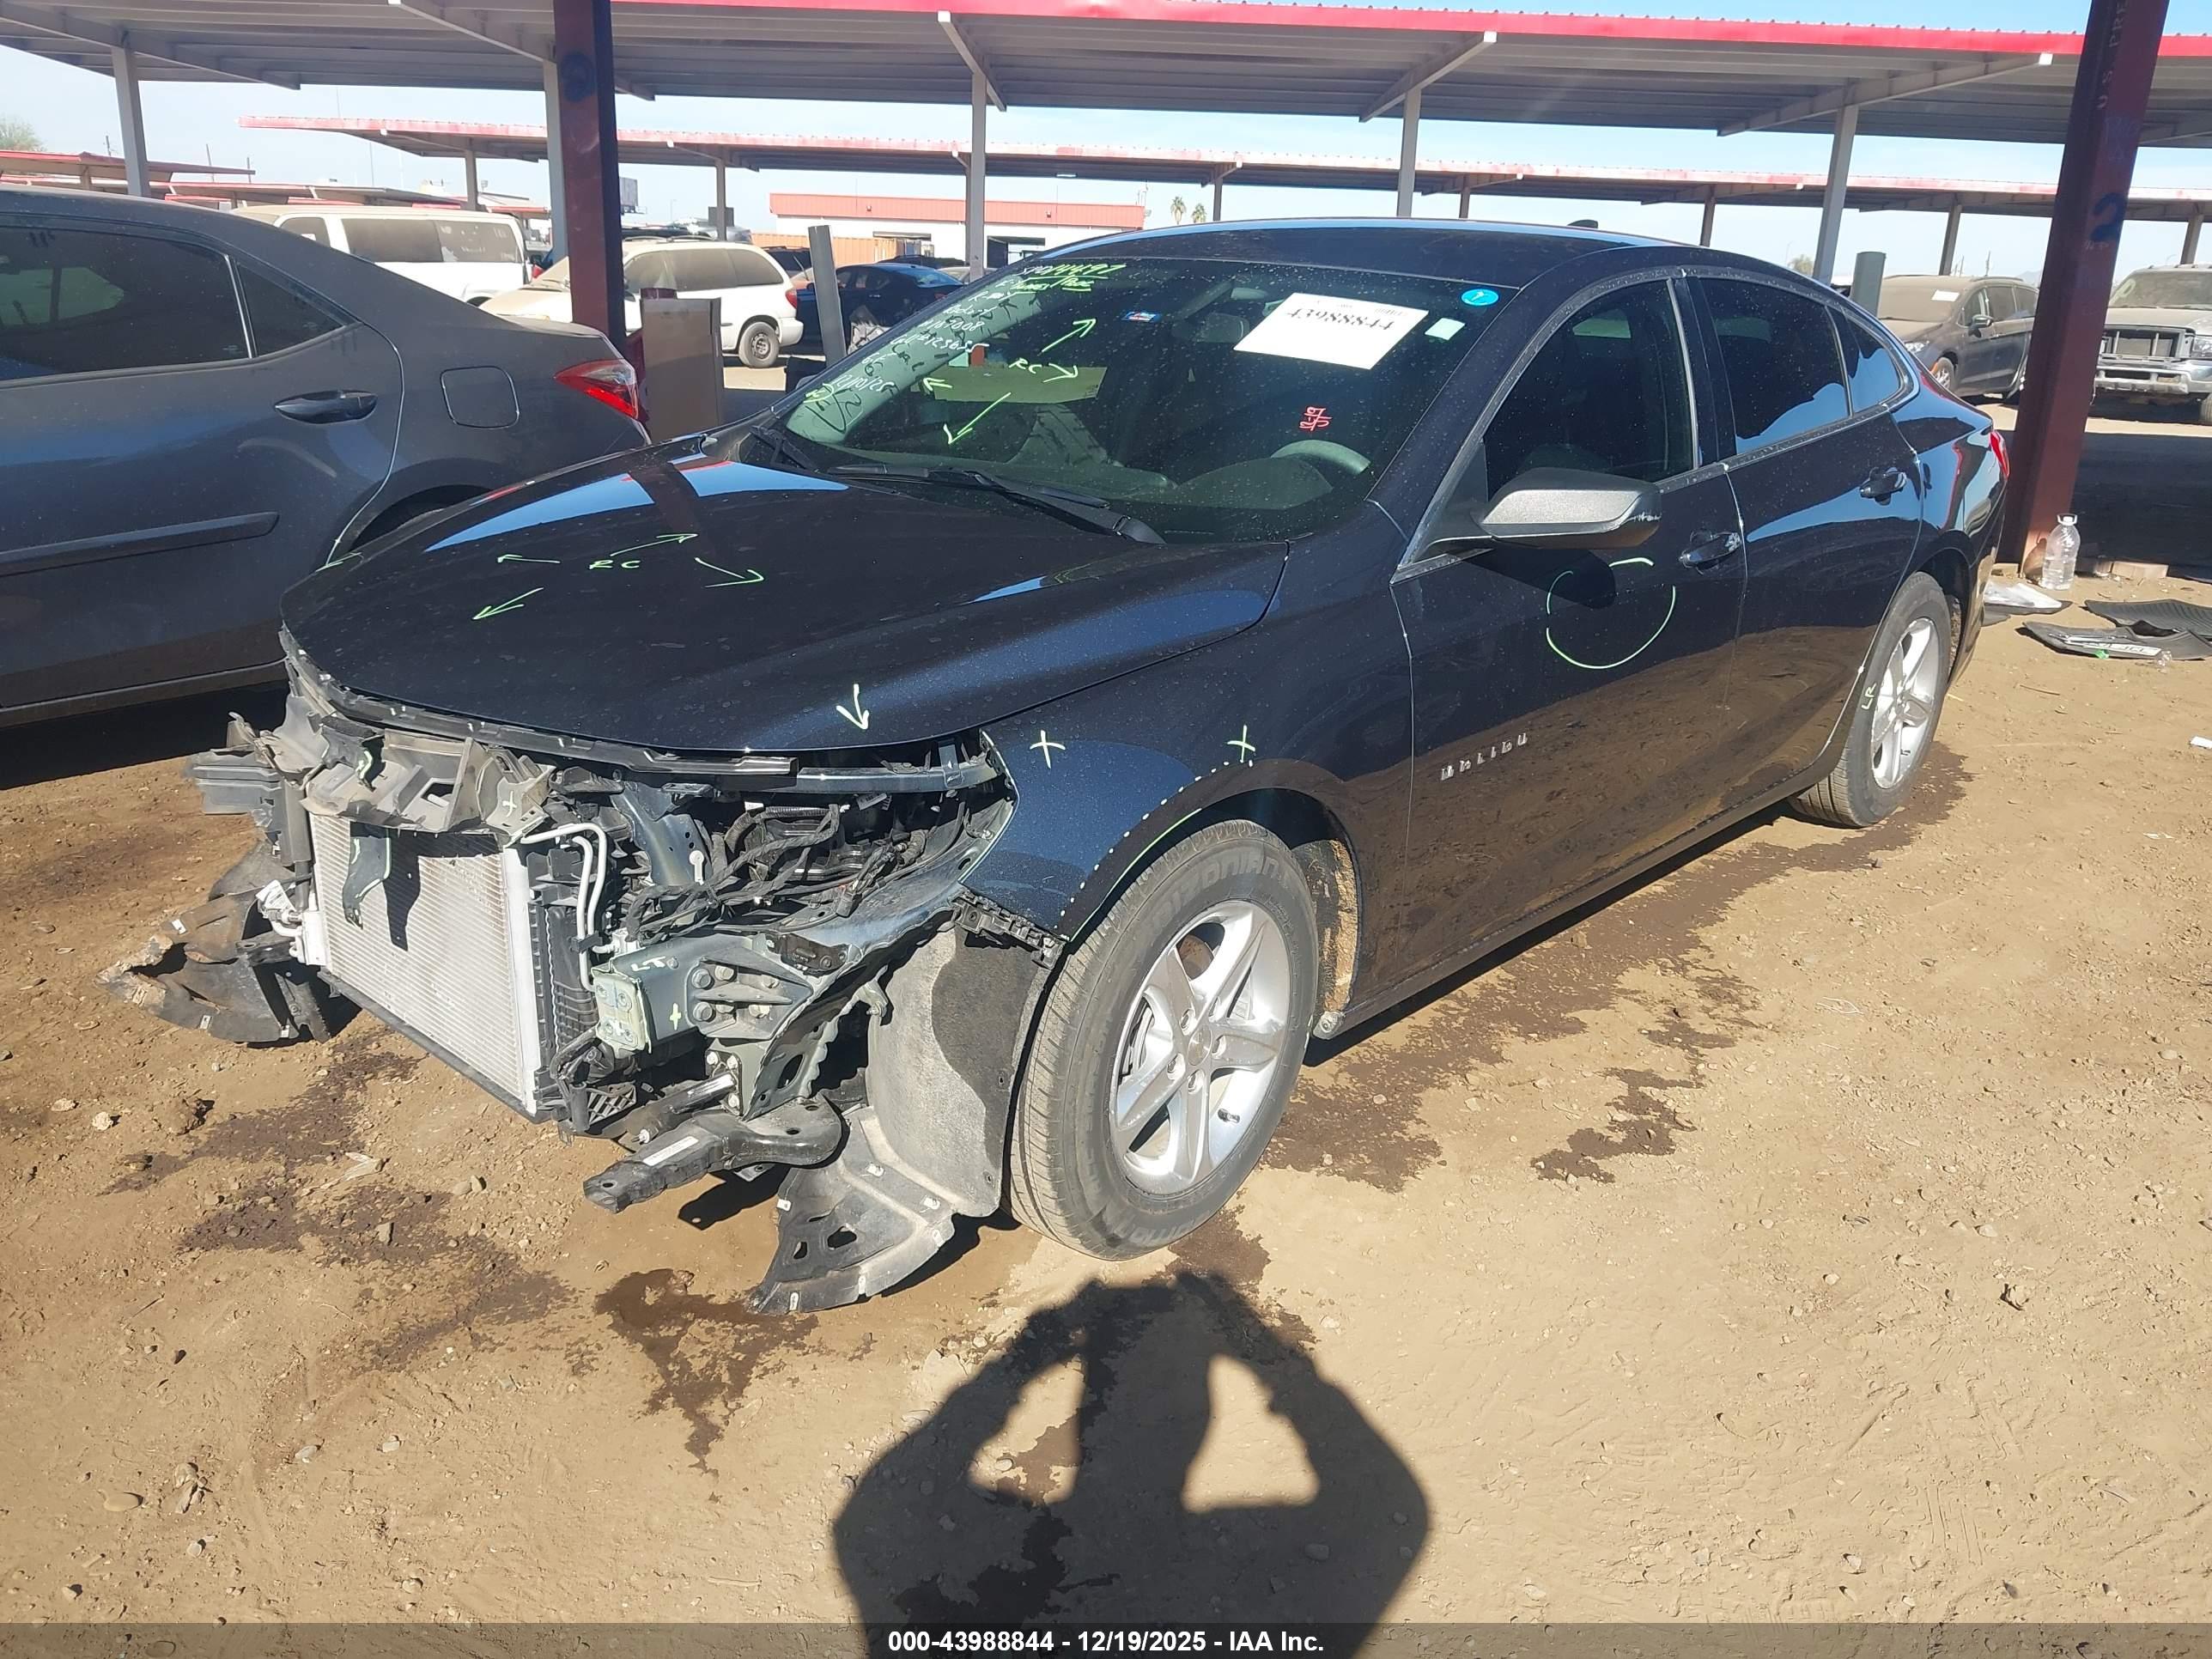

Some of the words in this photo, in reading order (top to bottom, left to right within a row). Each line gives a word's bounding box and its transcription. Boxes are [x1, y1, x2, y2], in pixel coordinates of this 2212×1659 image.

[2091, 191, 2129, 242] 2
[1288, 307, 1395, 331] 43988844
[1009, 357, 1042, 374] RC
[1861, 683, 1877, 710] LR
